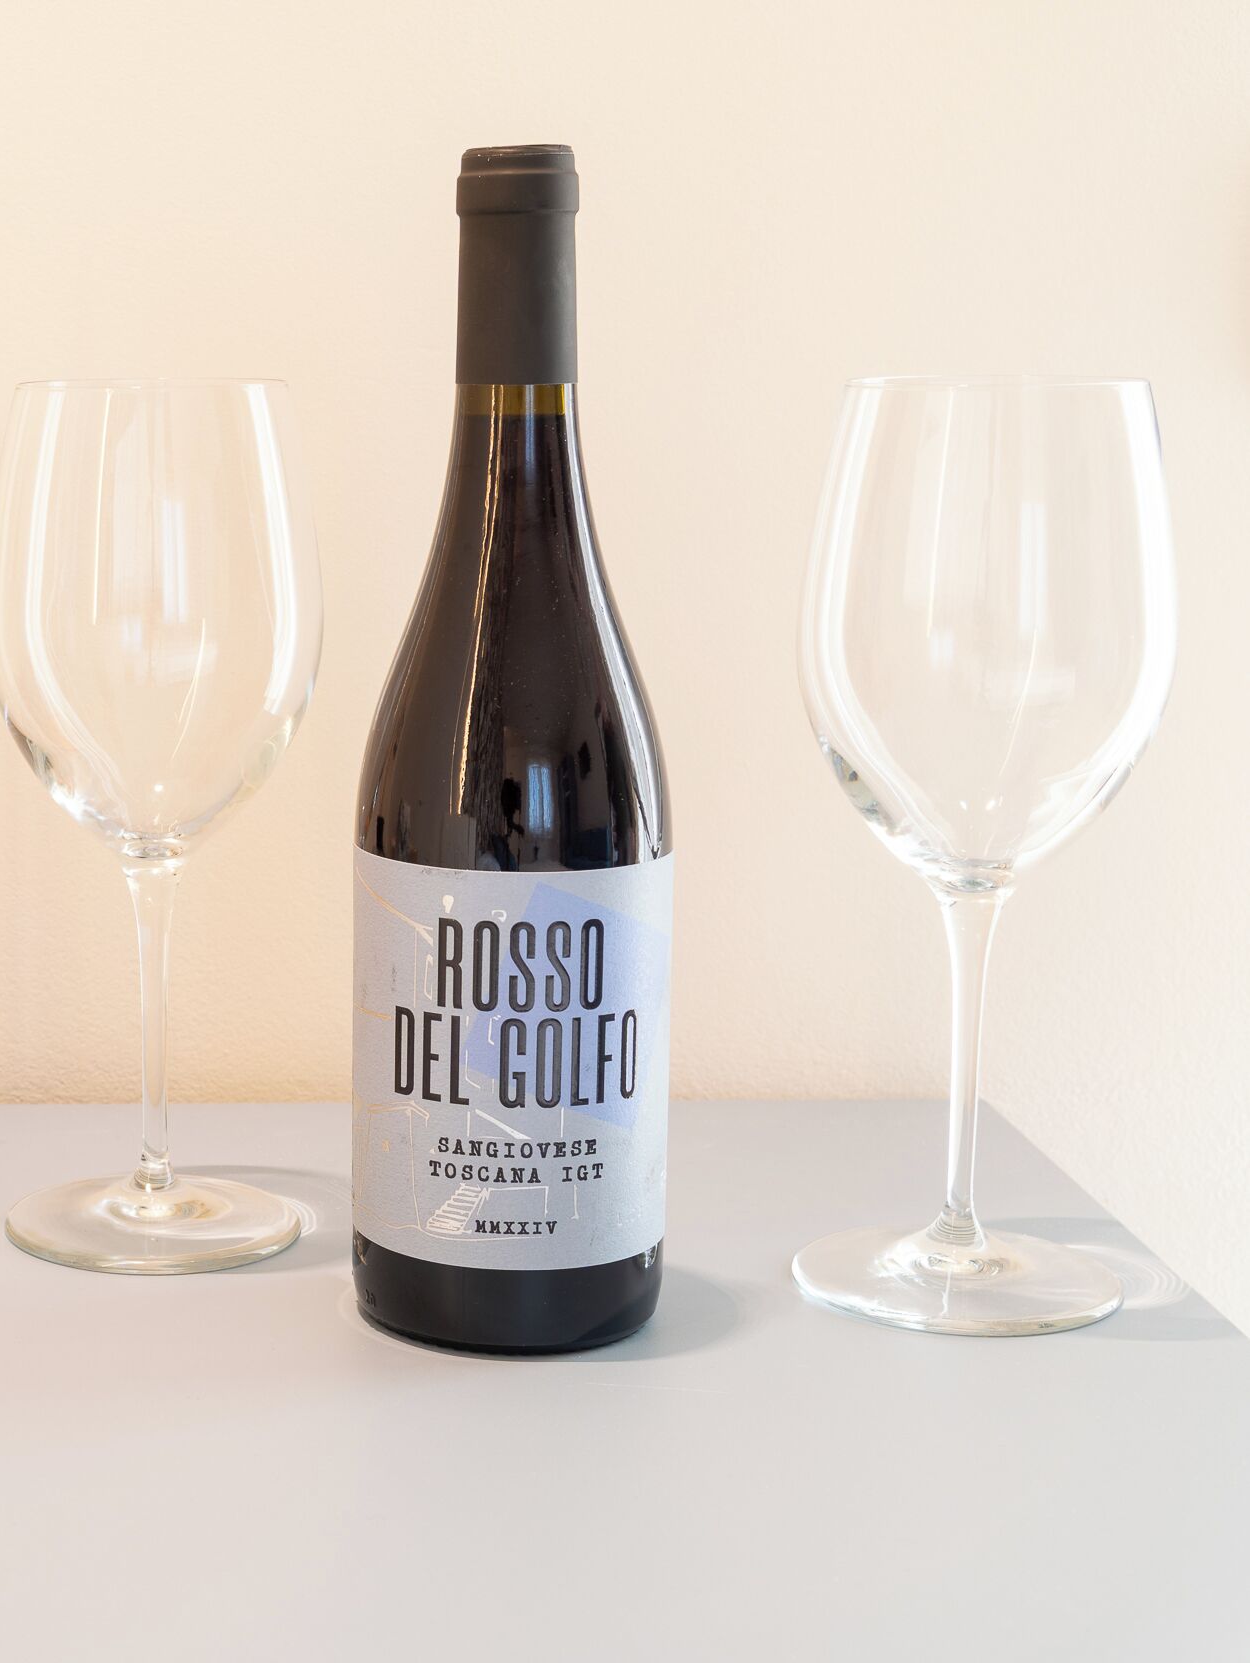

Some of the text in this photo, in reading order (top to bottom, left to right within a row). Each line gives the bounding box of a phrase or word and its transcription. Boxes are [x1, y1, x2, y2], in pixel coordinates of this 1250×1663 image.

[437, 917, 604, 1012] ROSSO
[394, 1006, 637, 1108] DEL GOLFO
[438, 1137, 597, 1158] SANGIOVESE
[429, 1160, 604, 1183] TOSCANA IGT
[475, 1220, 557, 1234] MMXXIV
